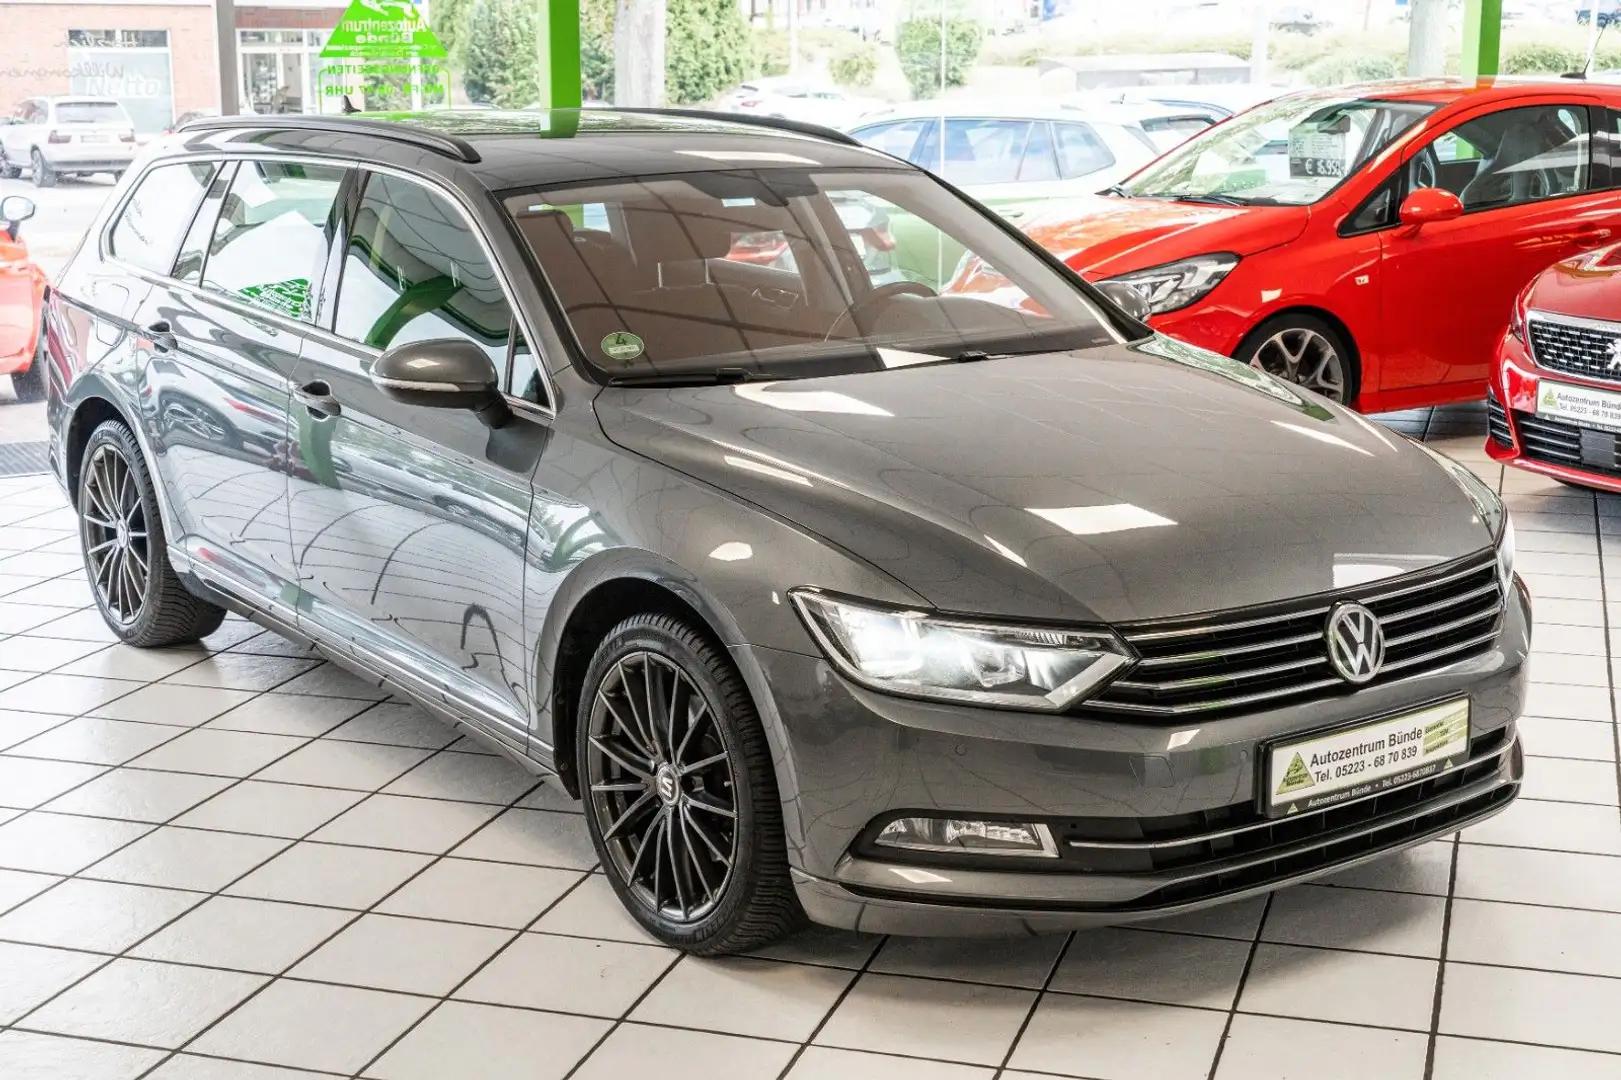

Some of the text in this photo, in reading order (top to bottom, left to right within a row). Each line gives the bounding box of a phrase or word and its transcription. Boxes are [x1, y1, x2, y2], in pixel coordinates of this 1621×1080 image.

[1310, 739, 1386, 767] Autozentrum
[1388, 727, 1423, 748] Bünde
[1314, 769, 1333, 783] Tel.
[1335, 760, 1365, 778] 05223
[1373, 754, 1386, 768] 68
[1388, 750, 1400, 764] 70
[1401, 745, 1418, 760] 839
[1307, 792, 1351, 808] Autozentrum
[1351, 784, 1372, 797] Bünde
